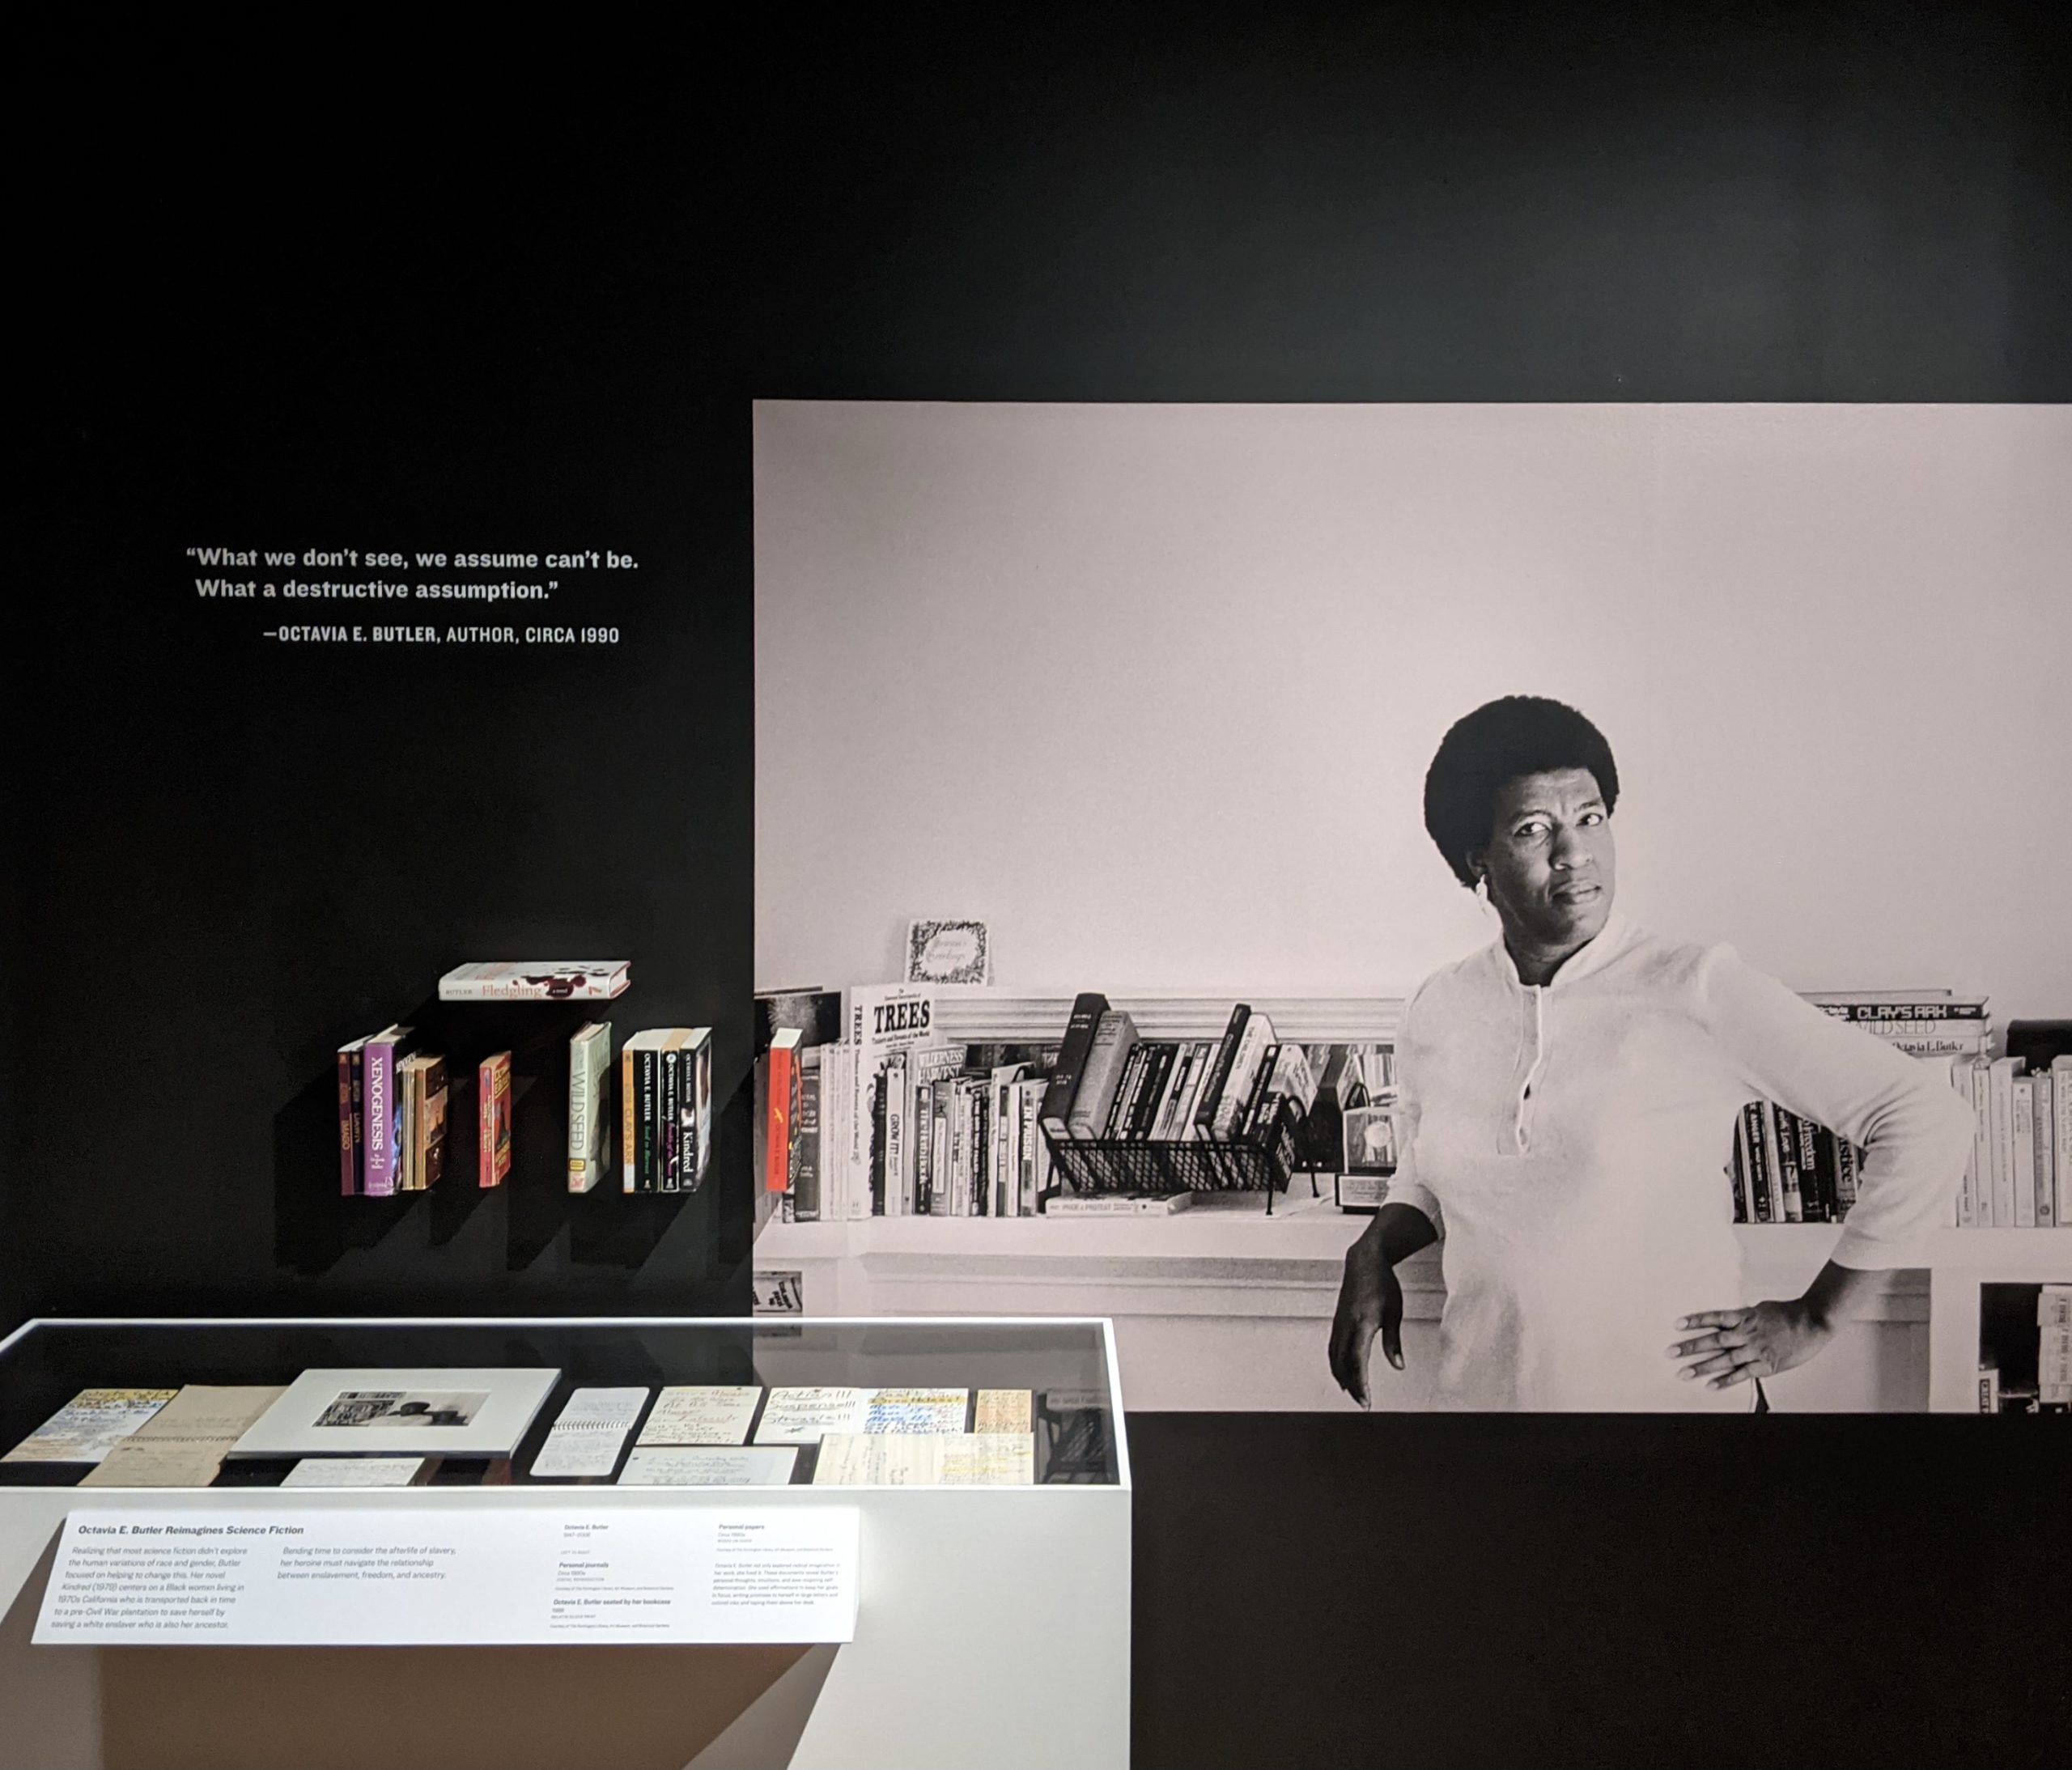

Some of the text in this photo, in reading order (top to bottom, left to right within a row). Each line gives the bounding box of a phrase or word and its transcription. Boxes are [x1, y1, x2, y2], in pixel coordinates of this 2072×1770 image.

[187, 548, 638, 569] “What we don’t see, we assume can’t be.
[196, 579, 558, 602] What a destructive assumption.”
[264, 626, 618, 644] —OCTAVIA E. BUTLER, AUTHOR, CIRCA 1990
[482, 984, 543, 999] Fledgling
[874, 1000, 930, 1034] TREES
[1858, 1007, 1913, 1019] CLAY'S
[854, 1005, 863, 1046] TREES
[1895, 1020, 1936, 1034] SEED
[372, 1056, 384, 1150] XENOGENESIS
[571, 1071, 585, 1151] WILD SEED
[624, 1109, 633, 1140] CLAY'S
[1022, 1106, 1033, 1161] IN PRISON
[1751, 1114, 1760, 1144] ANGER
[341, 1120, 350, 1150] IMAGO
[890, 1114, 899, 1155] GROW IT!
[683, 1131, 694, 1173] Kindred
[1802, 1127, 1816, 1170] Freedom
[1838, 1138, 1853, 1182] ustice
[79, 1526, 304, 1536] Octavia E. Butler Reimagines Science Fiction
[72, 1547, 105, 1556] Realizing
[173, 1547, 196, 1555] fiction
[197, 1547, 219, 1556] didn’t
[220, 1547, 248, 1556] explore
[282, 1547, 314, 1555] Bending
[376, 1547, 388, 1555] the
[388, 1546, 418, 1554] afterlife
[419, 1546, 427, 1554] of
[429, 1547, 456, 1555] slavery,
[68, 1559, 81, 1567] the
[83, 1559, 108, 1567] human
[146, 1559, 155, 1567] of
[173, 1559, 189, 1567] and
[189, 1559, 215, 1568] gender,
[218, 1559, 241, 1567] Butler
[280, 1559, 293, 1567] her
[294, 1559, 322, 1567] heroine
[377, 1559, 389, 1567] the
[390, 1559, 434, 1567] relationship
[107, 1571, 134, 1580] helping
[135, 1572, 143, 1580] to
[144, 1572, 172, 1580] change
[362, 1571, 395, 1579] freedom,
[62, 1583, 91, 1591] Kindred
[92, 1583, 117, 1592] (1979)
[165, 1583, 186, 1591] Black
[216, 1583, 236, 1592] living
[83, 1596, 118, 1604] California
[145, 1596, 190, 1604] transported
[190, 1596, 209, 1604] back
[70, 1608, 103, 1616] pre-Civil
[120, 1608, 159, 1617] plantation
[189, 1608, 215, 1616] herself
[215, 1608, 225, 1617] by
[50, 1621, 76, 1629] saving
[83, 1620, 104, 1628] white
[105, 1620, 136, 1628] enslaver
[138, 1620, 154, 1629] who
[163, 1620, 180, 1628] also
[180, 1620, 193, 1629] her
